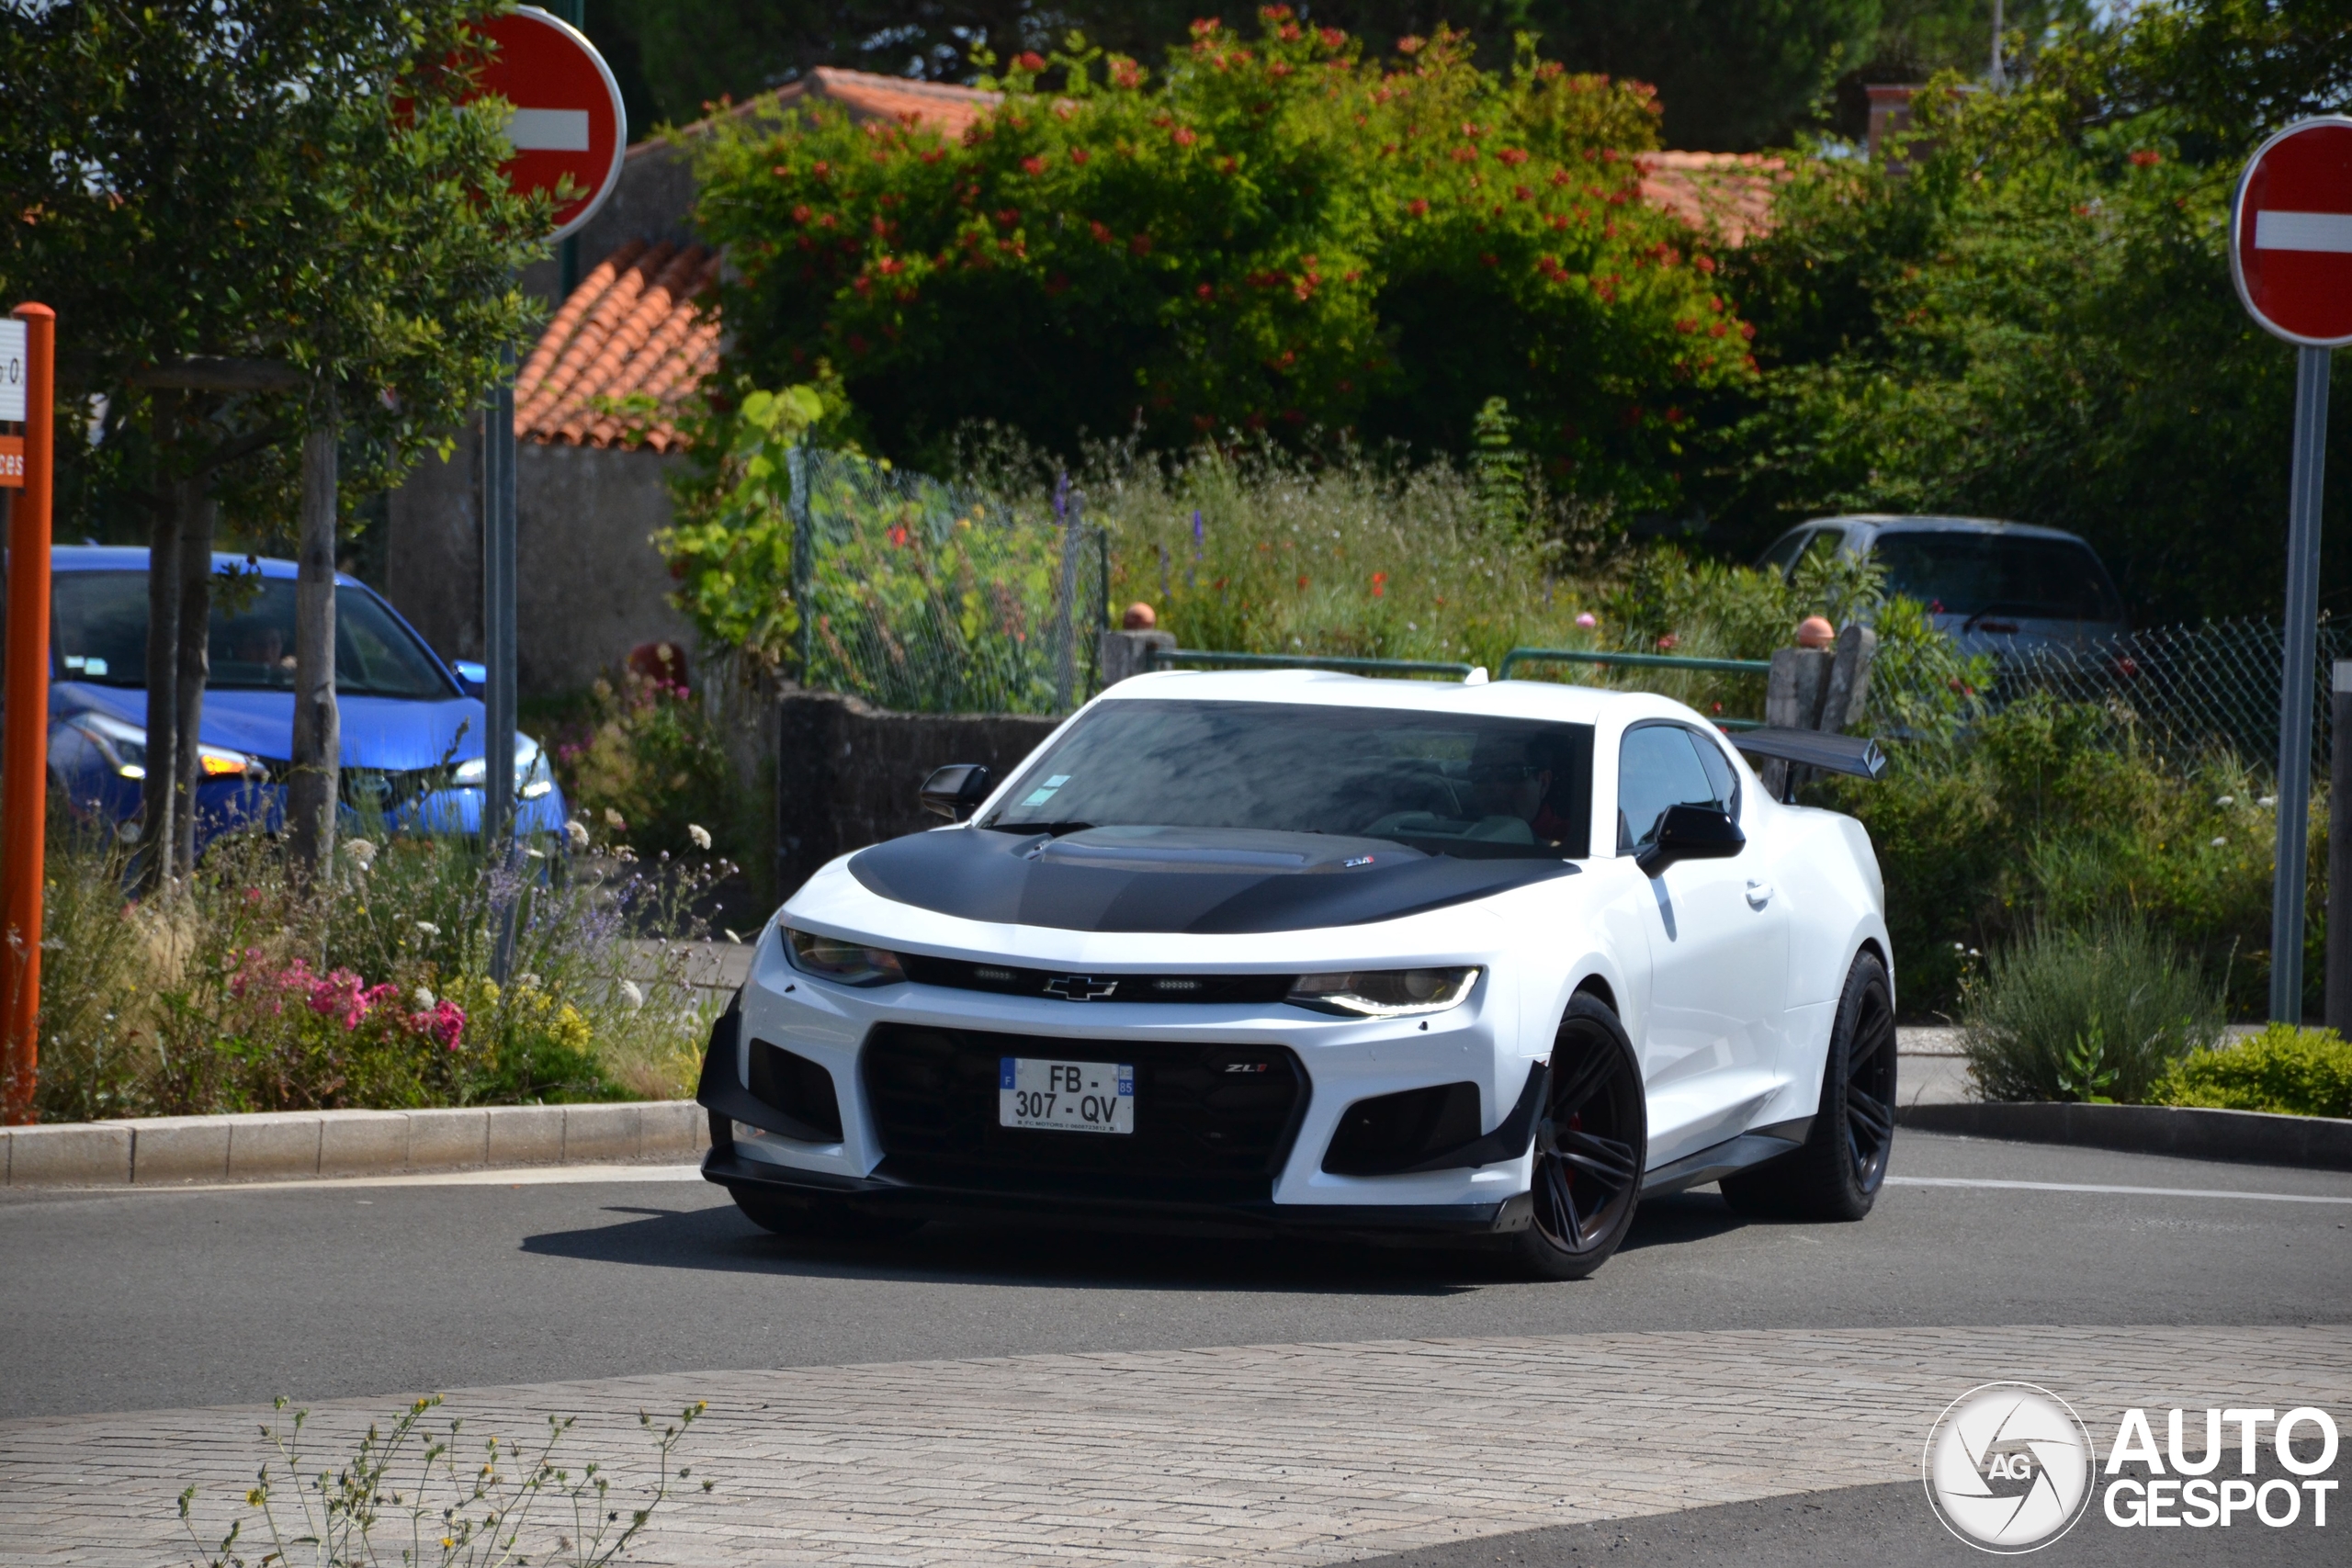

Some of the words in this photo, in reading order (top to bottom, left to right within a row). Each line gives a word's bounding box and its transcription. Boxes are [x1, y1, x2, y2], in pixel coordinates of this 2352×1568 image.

[1225, 1064, 1267, 1073] ZL1
[1004, 1077, 1012, 1086] F
[1050, 1065, 1081, 1093] FB
[1119, 1082, 1133, 1093] 85
[1015, 1091, 1057, 1119] 307
[1080, 1095, 1117, 1123] QV
